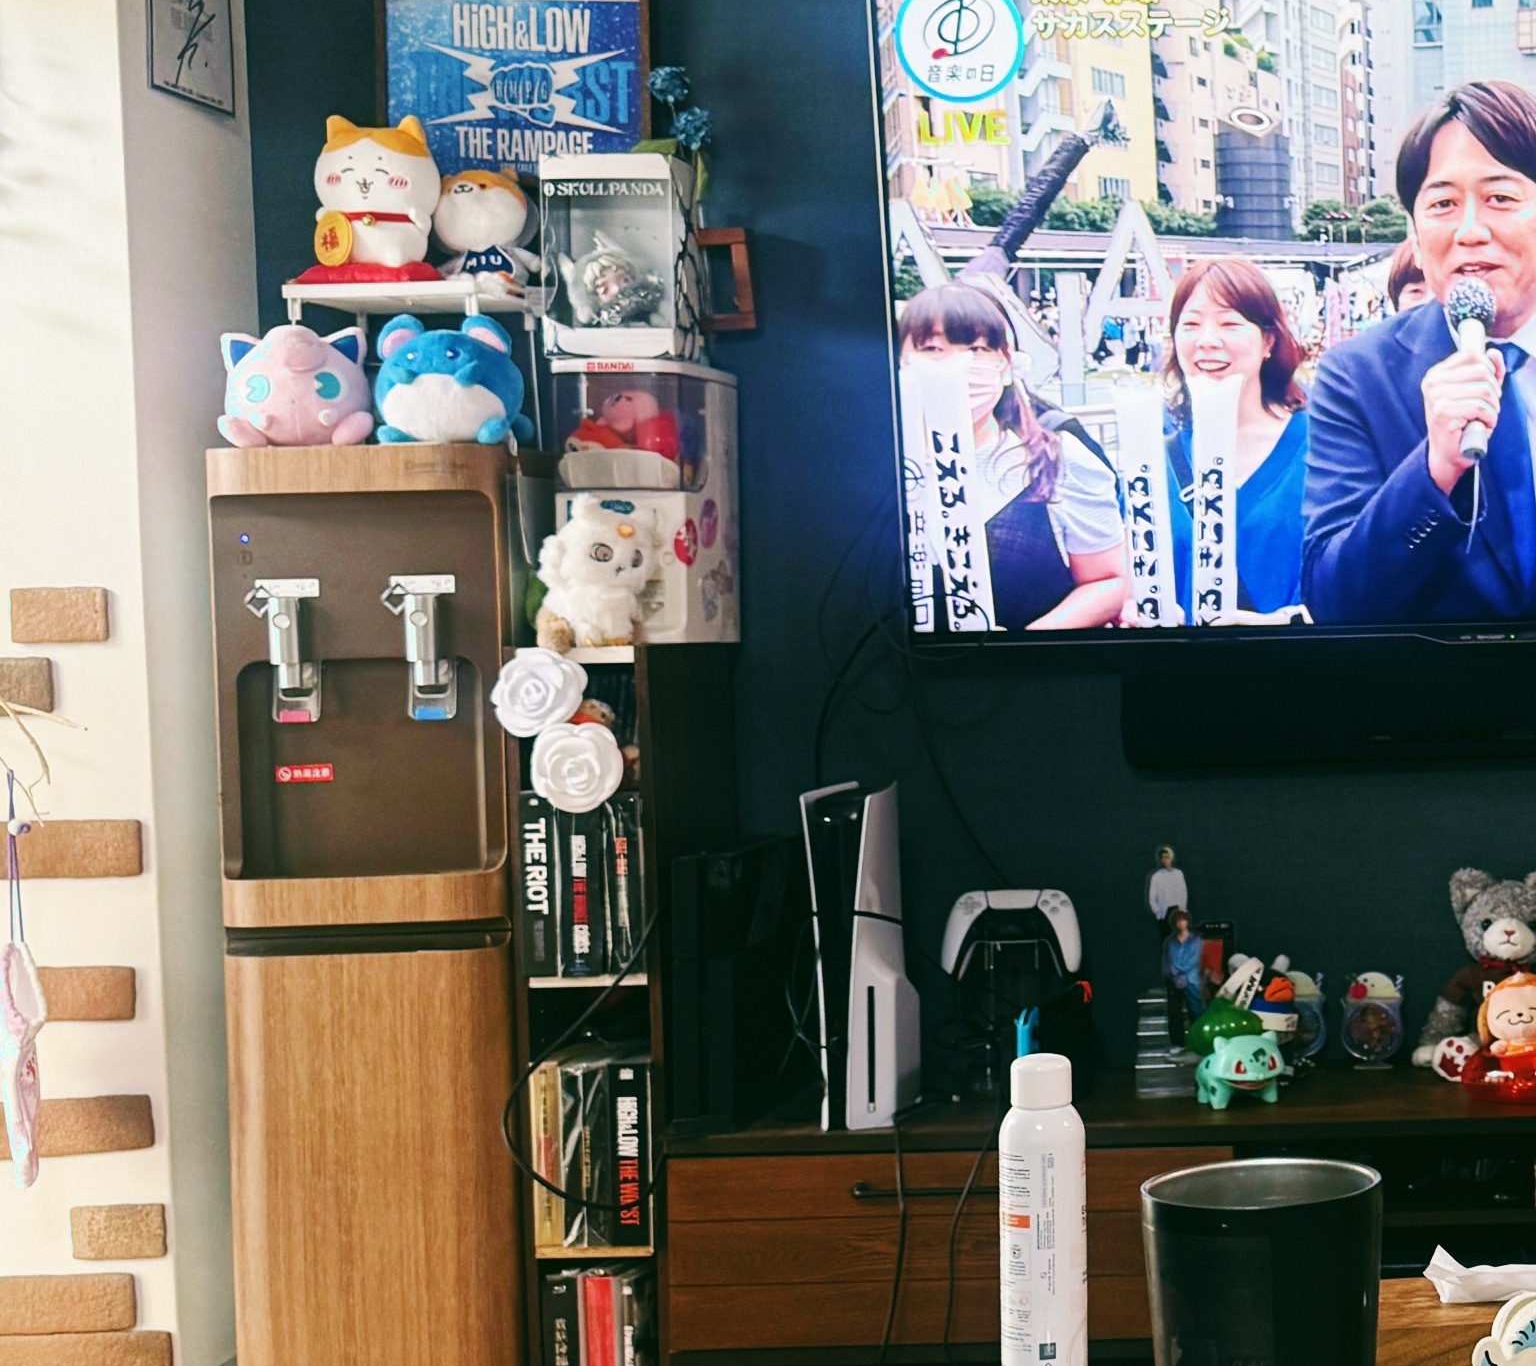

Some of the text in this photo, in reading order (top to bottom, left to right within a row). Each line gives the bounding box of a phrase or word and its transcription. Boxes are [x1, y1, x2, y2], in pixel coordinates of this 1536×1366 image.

[1031, 8, 1232, 40] サカスステージ
[926, 63, 995, 84] 音楽の日
[455, 125, 594, 163] THE RAMPAGE
[917, 110, 1010, 146] LIVE
[556, 181, 665, 197] SKULLPANDA
[523, 818, 547, 864] THE
[525, 865, 549, 915] RIOT
[618, 1182, 640, 1226] WOST
